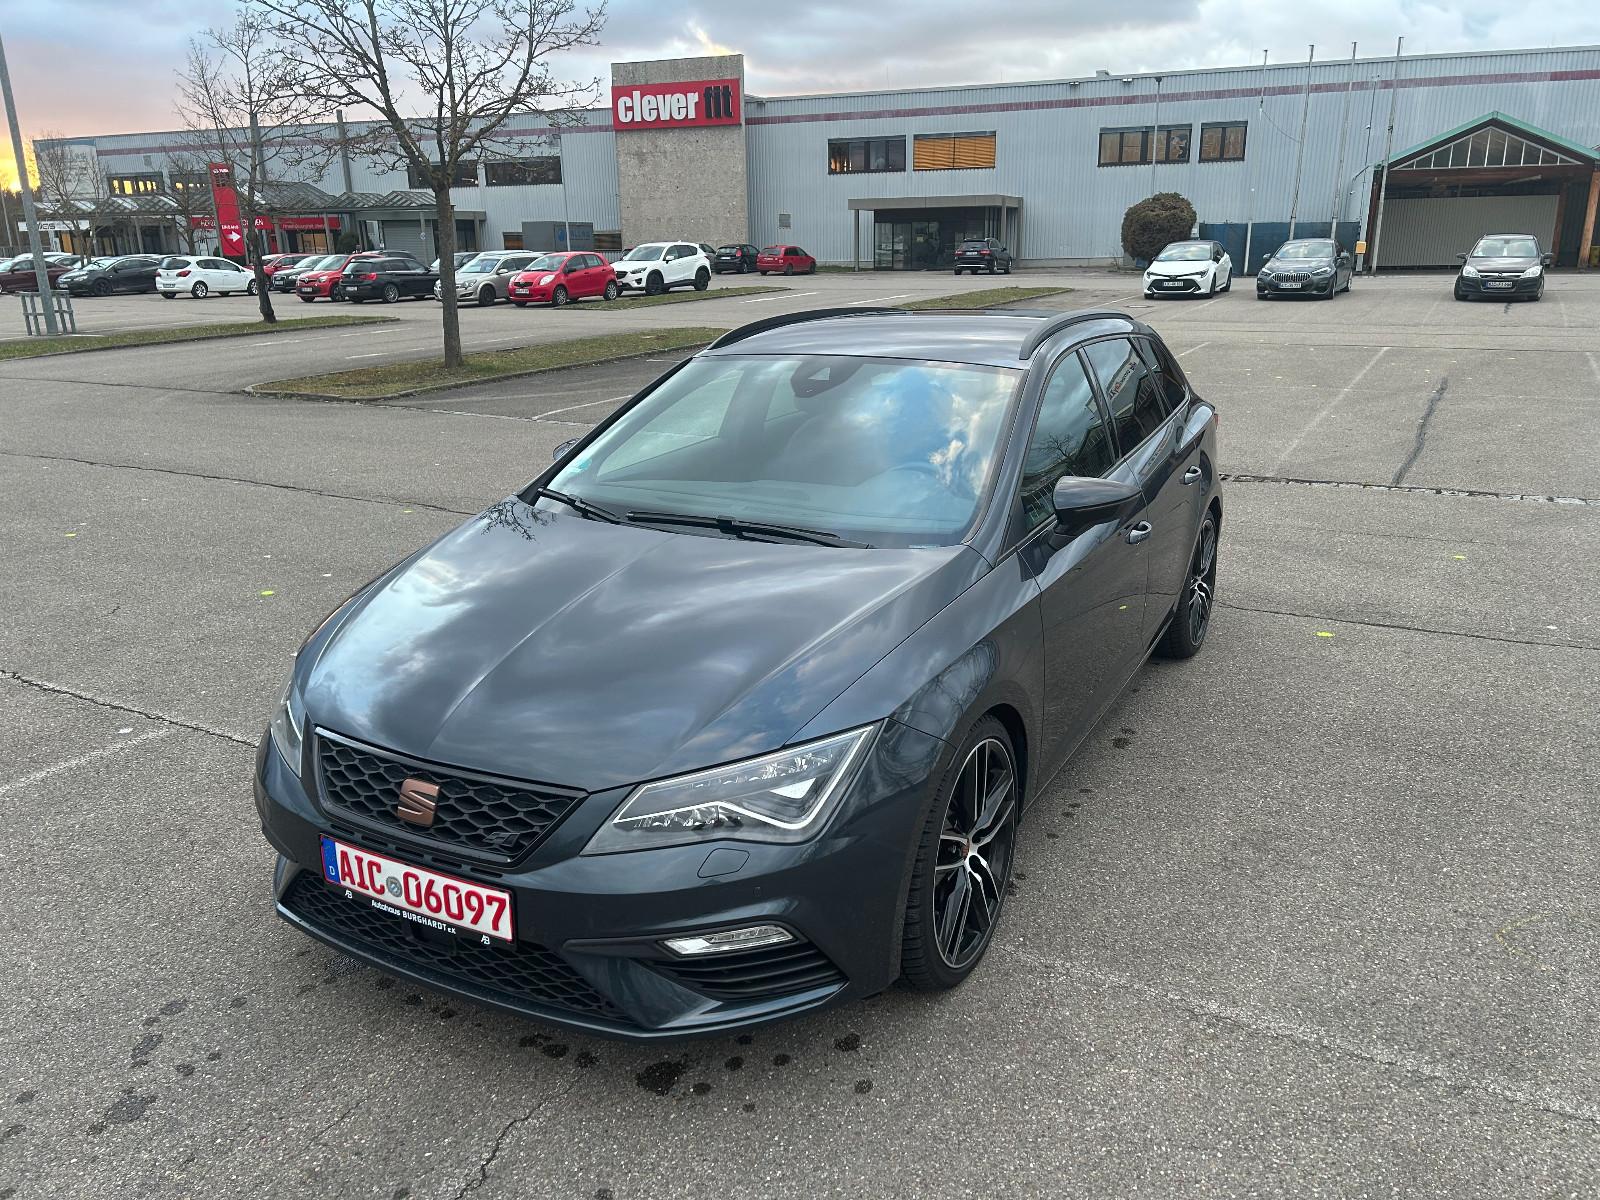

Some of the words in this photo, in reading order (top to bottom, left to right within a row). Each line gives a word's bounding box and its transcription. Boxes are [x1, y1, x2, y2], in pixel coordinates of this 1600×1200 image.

[618, 91, 699, 123] clever
[704, 85, 733, 119] fit
[340, 850, 385, 896] AIC
[402, 870, 507, 932] 06097
[371, 900, 401, 916] Autohaus
[402, 910, 447, 931] BURGHARDT
